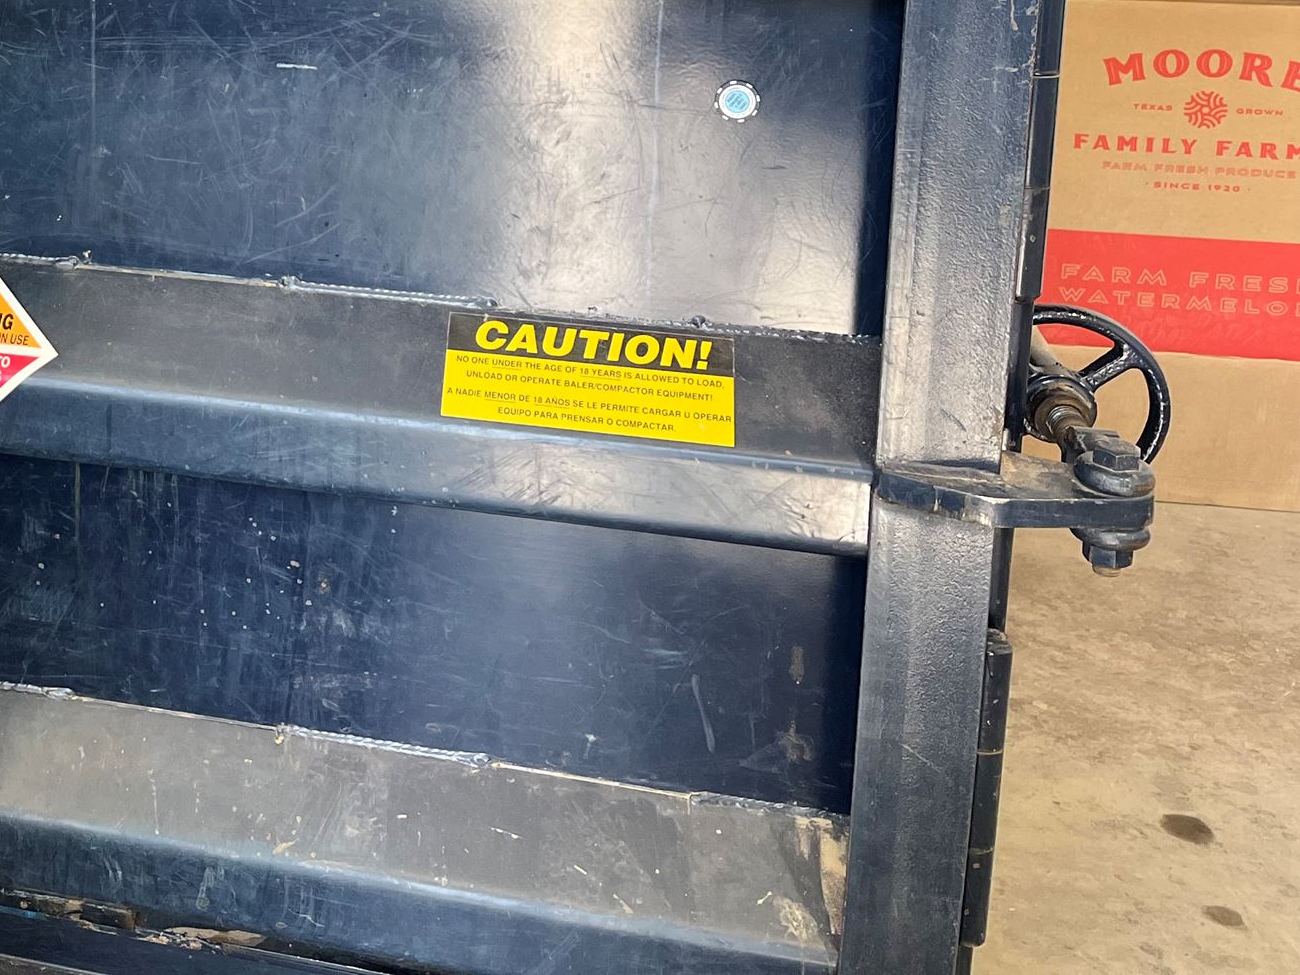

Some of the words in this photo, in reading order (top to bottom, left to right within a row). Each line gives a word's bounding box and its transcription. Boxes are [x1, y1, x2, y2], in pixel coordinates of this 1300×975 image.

[1103, 49, 1300, 93] MOORE
[1133, 103, 1173, 112] TEXAS
[1236, 107, 1284, 117] GROWN
[1073, 133, 1198, 156] FAMILY
[1102, 161, 1148, 173] FARM
[1154, 163, 1209, 175] FRESH
[1214, 167, 1298, 179] PRODUCE
[1153, 181, 1200, 191] SINCE
[1208, 184, 1242, 193] 1920
[1060, 263, 1168, 287] FARM
[1189, 271, 1300, 295] FRES
[1058, 285, 1300, 317] WATERMELO
[10, 333, 30, 347] USE
[475, 320, 713, 371] CAUTION!
[456, 355, 470, 363] NO
[472, 357, 490, 365] ONE
[492, 359, 522, 367] UNDER
[524, 361, 541, 370] THE
[544, 363, 562, 373] AGE
[564, 365, 576, 374] OF
[580, 367, 589, 375] 18
[592, 369, 622, 378] YEARS
[624, 371, 632, 379] IS
[635, 373, 680, 384] ALLOWED
[682, 377, 694, 385] TO
[466, 370, 502, 381] UNLOAD
[505, 374, 518, 382] OR
[520, 375, 562, 387] OPERATE
[564, 379, 654, 395] BALER/COMPACTOR
[657, 389, 713, 401] EQUIPMENT!
[446, 387, 453, 395] A
[455, 389, 482, 397] NADIE
[484, 391, 516, 401] MENOR
[518, 395, 530, 403] DE
[534, 396, 542, 404] 18
[545, 395, 570, 407] AÑOS
[572, 400, 584, 408] SE
[586, 401, 598, 409] LE
[600, 403, 640, 413] PERMITE
[642, 407, 682, 418] CARGAR
[684, 411, 690, 419] U
[693, 412, 732, 423] OPERAR
[498, 407, 532, 417] EQUIPO
[534, 410, 558, 420] PARA
[560, 413, 604, 425] PRENSAR
[606, 417, 614, 425] O
[616, 419, 676, 432] COMPACTAR.
